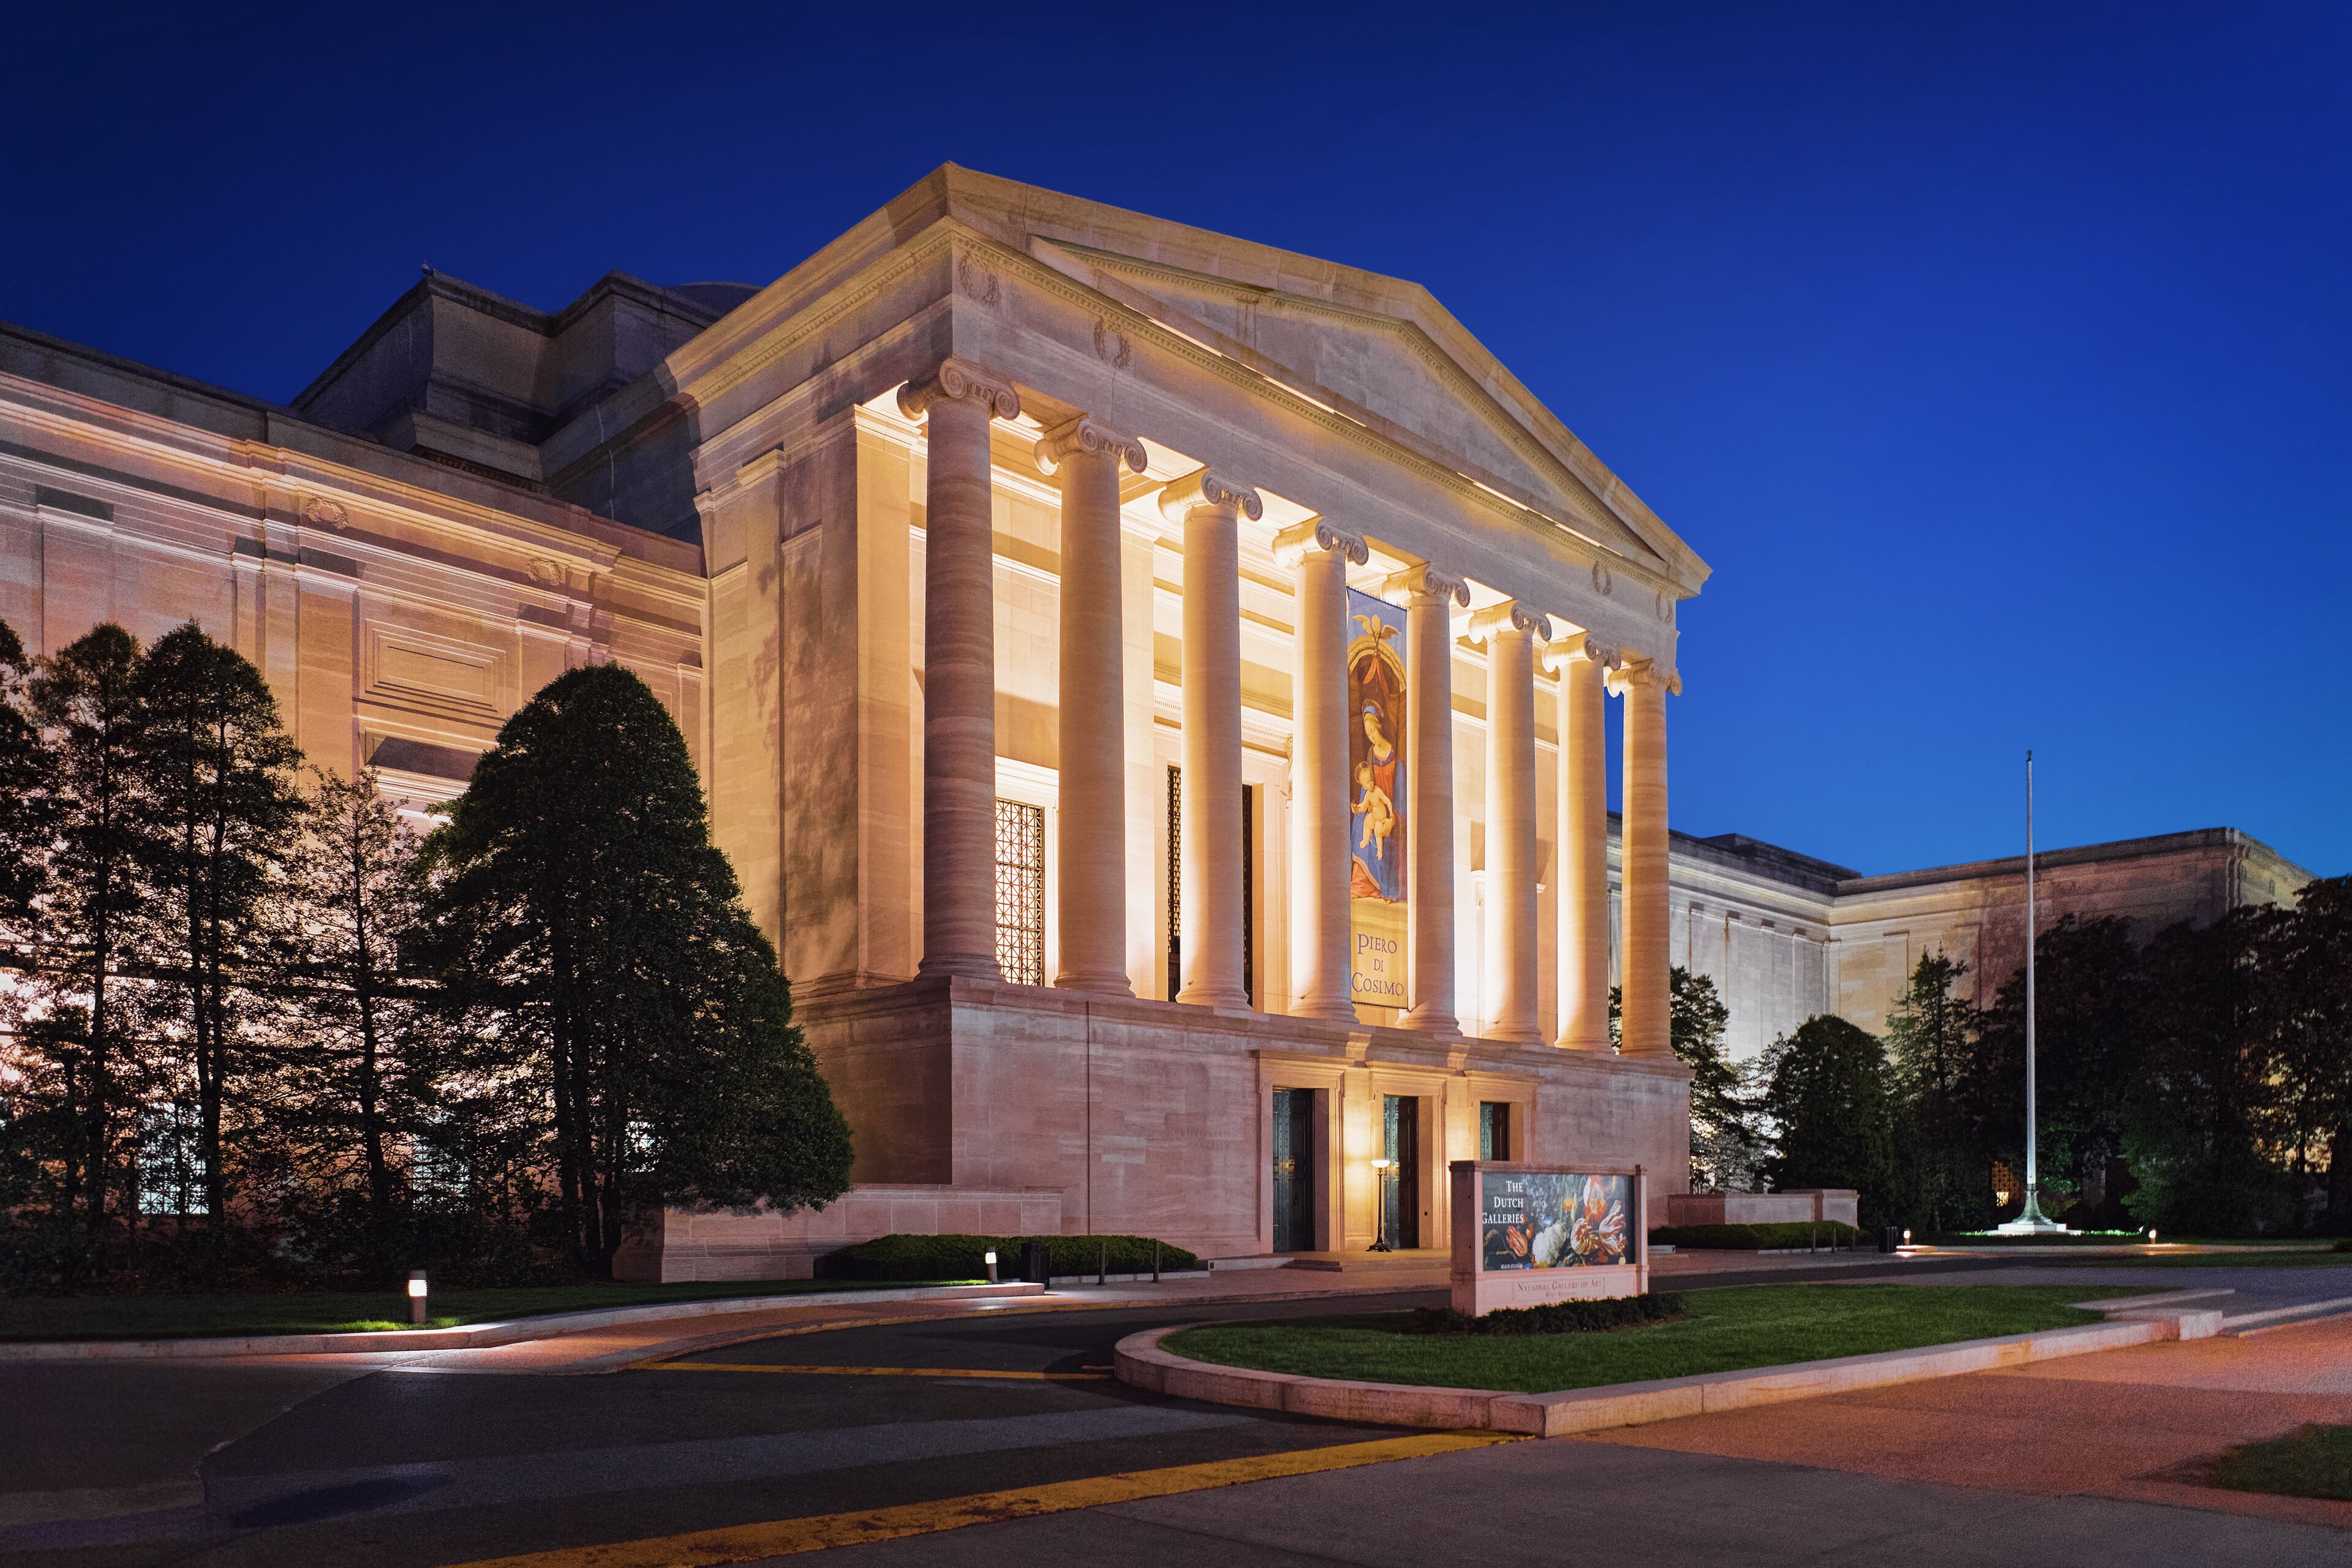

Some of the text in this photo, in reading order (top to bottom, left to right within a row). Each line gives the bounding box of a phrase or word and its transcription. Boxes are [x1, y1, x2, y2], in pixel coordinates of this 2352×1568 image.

[1357, 933, 1397, 954] PIERO
[1373, 959, 1384, 972] DI
[1351, 972, 1404, 996] COSIMO
[1506, 1180, 1523, 1192] THE
[1494, 1196, 1523, 1208] DUTCH
[1482, 1212, 1524, 1224] GALLERIES
[1517, 1281, 1550, 1291] NATIONAL
[1552, 1281, 1577, 1289] GALLERY
